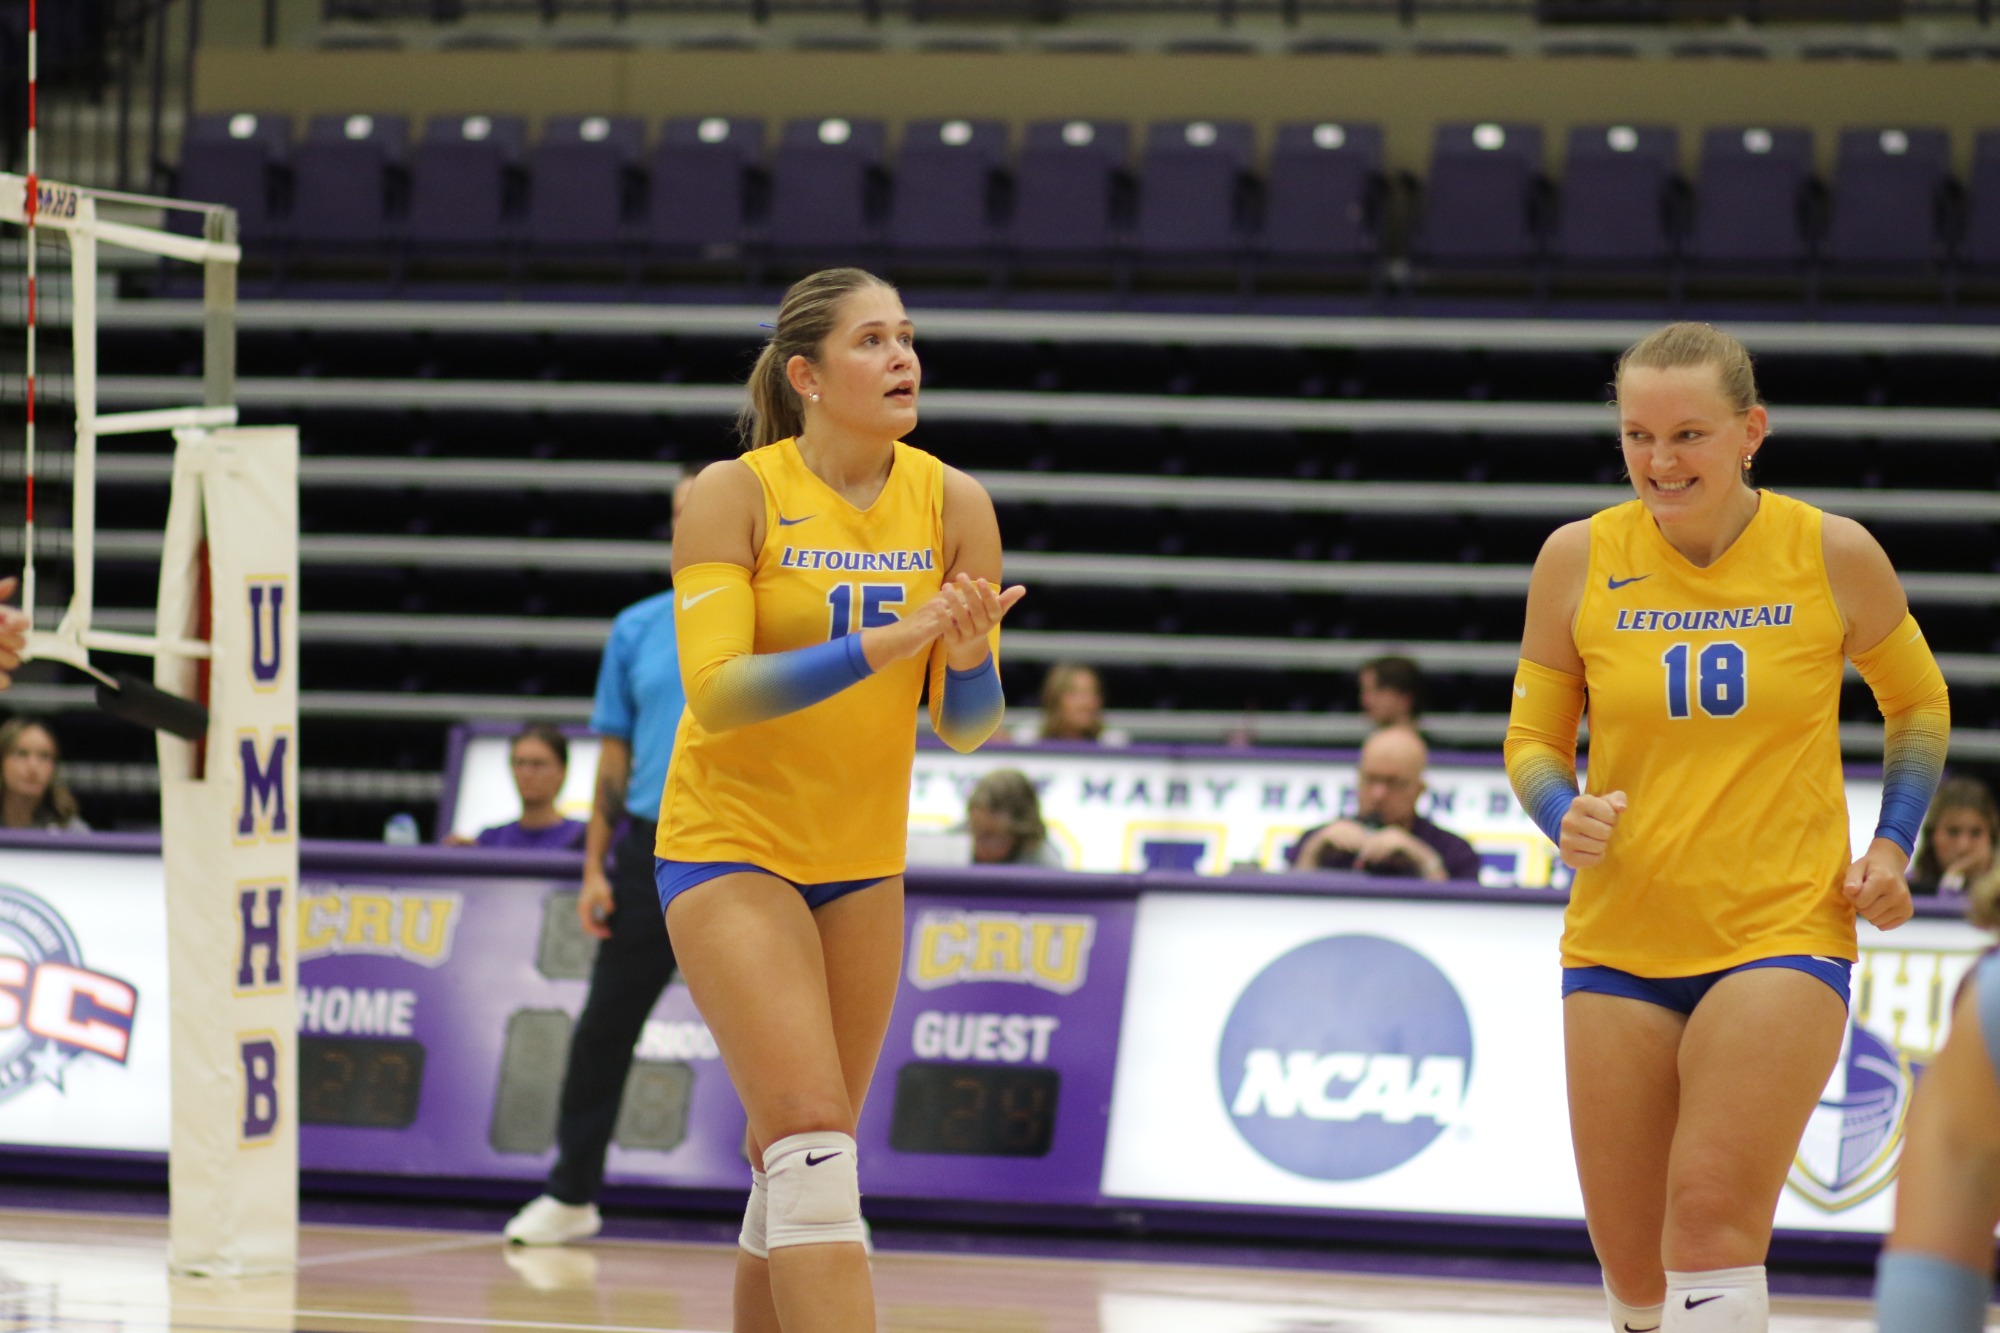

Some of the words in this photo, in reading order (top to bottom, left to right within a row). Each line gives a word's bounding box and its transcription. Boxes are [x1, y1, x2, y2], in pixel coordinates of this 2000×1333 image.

[24, 185, 79, 218] MHB
[1614, 603, 1796, 632] LETOURNEAU
[1661, 639, 1749, 721] 18
[298, 889, 460, 964] CRU
[911, 912, 1092, 991] CRU
[297, 984, 418, 1036] HOME
[912, 1010, 1061, 1063] GUEST
[1231, 1048, 1465, 1126] NCAA
